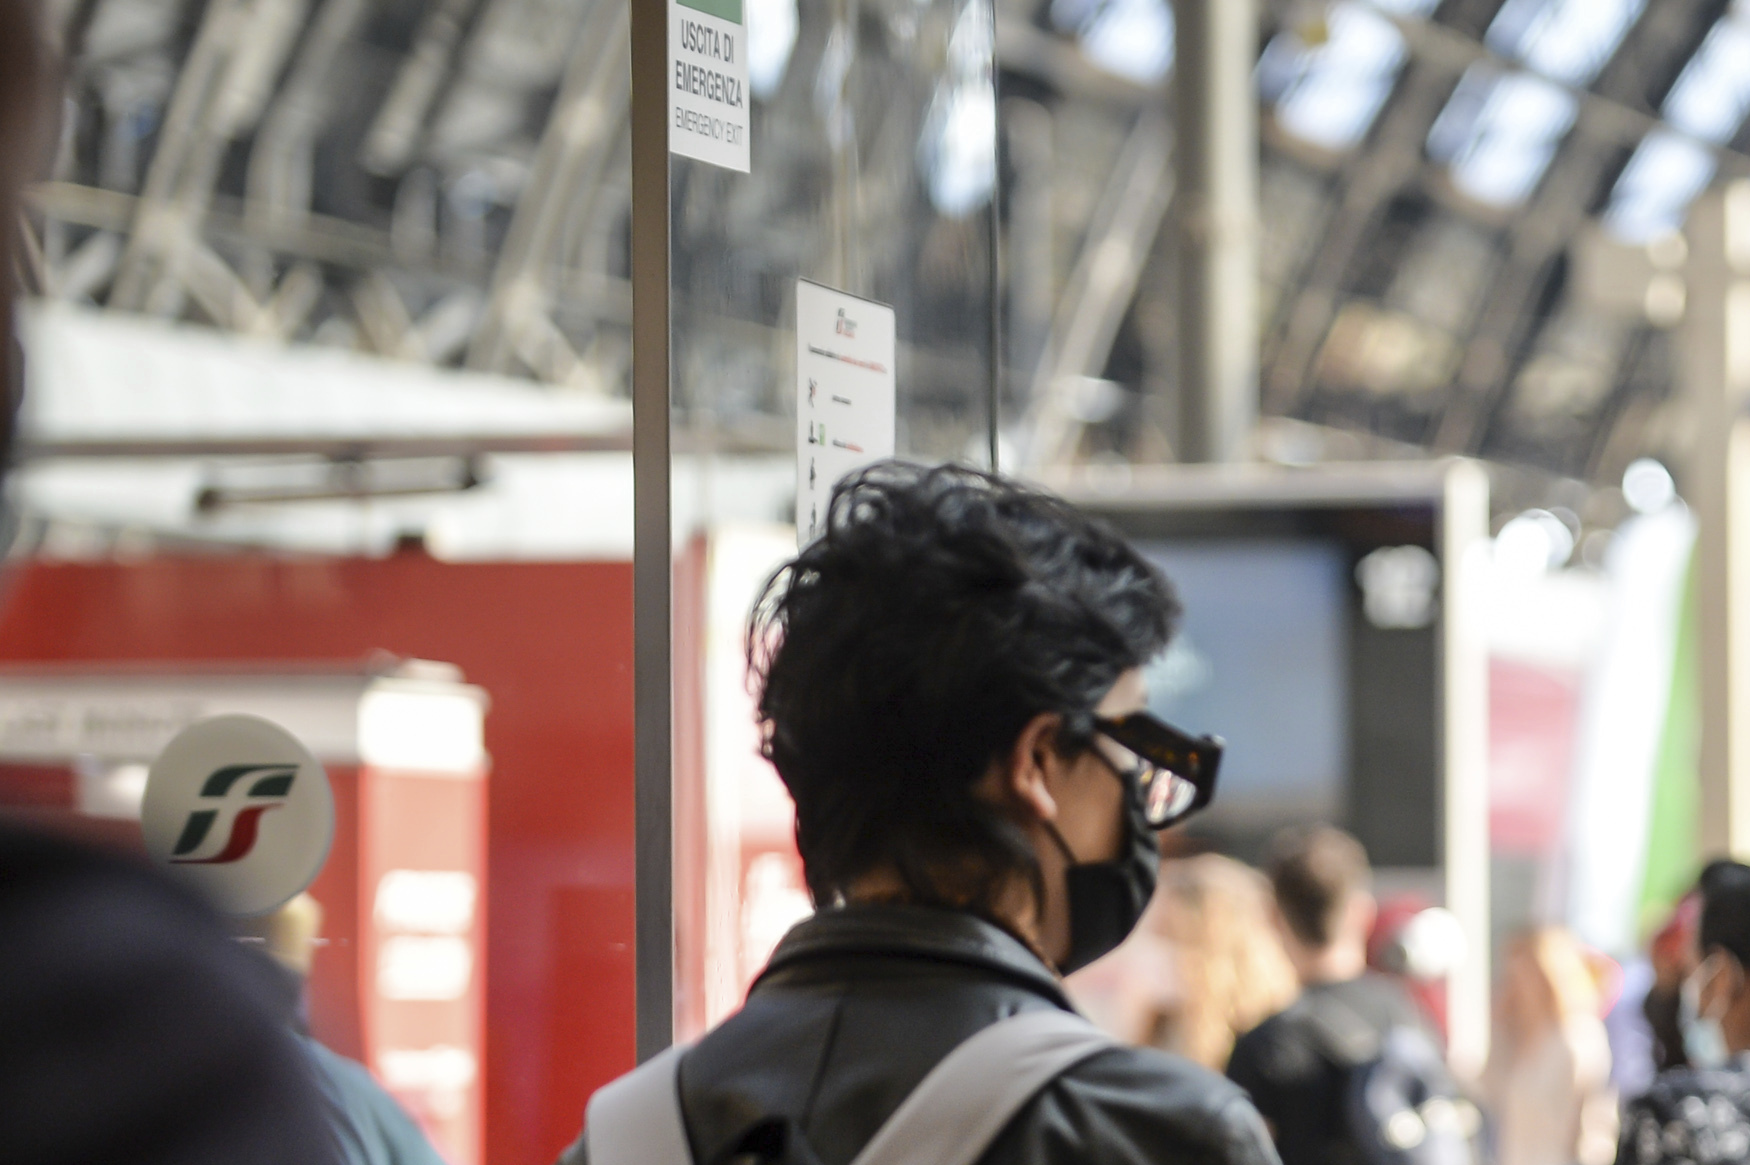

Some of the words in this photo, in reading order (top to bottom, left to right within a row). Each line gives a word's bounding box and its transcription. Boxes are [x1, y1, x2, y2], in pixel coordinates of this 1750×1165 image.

[680, 18, 721, 59] USCITA
[723, 32, 735, 64] DI
[675, 59, 743, 109] EMERGENZA
[675, 106, 725, 140] EMERGENCY
[725, 121, 743, 146] EXIT
